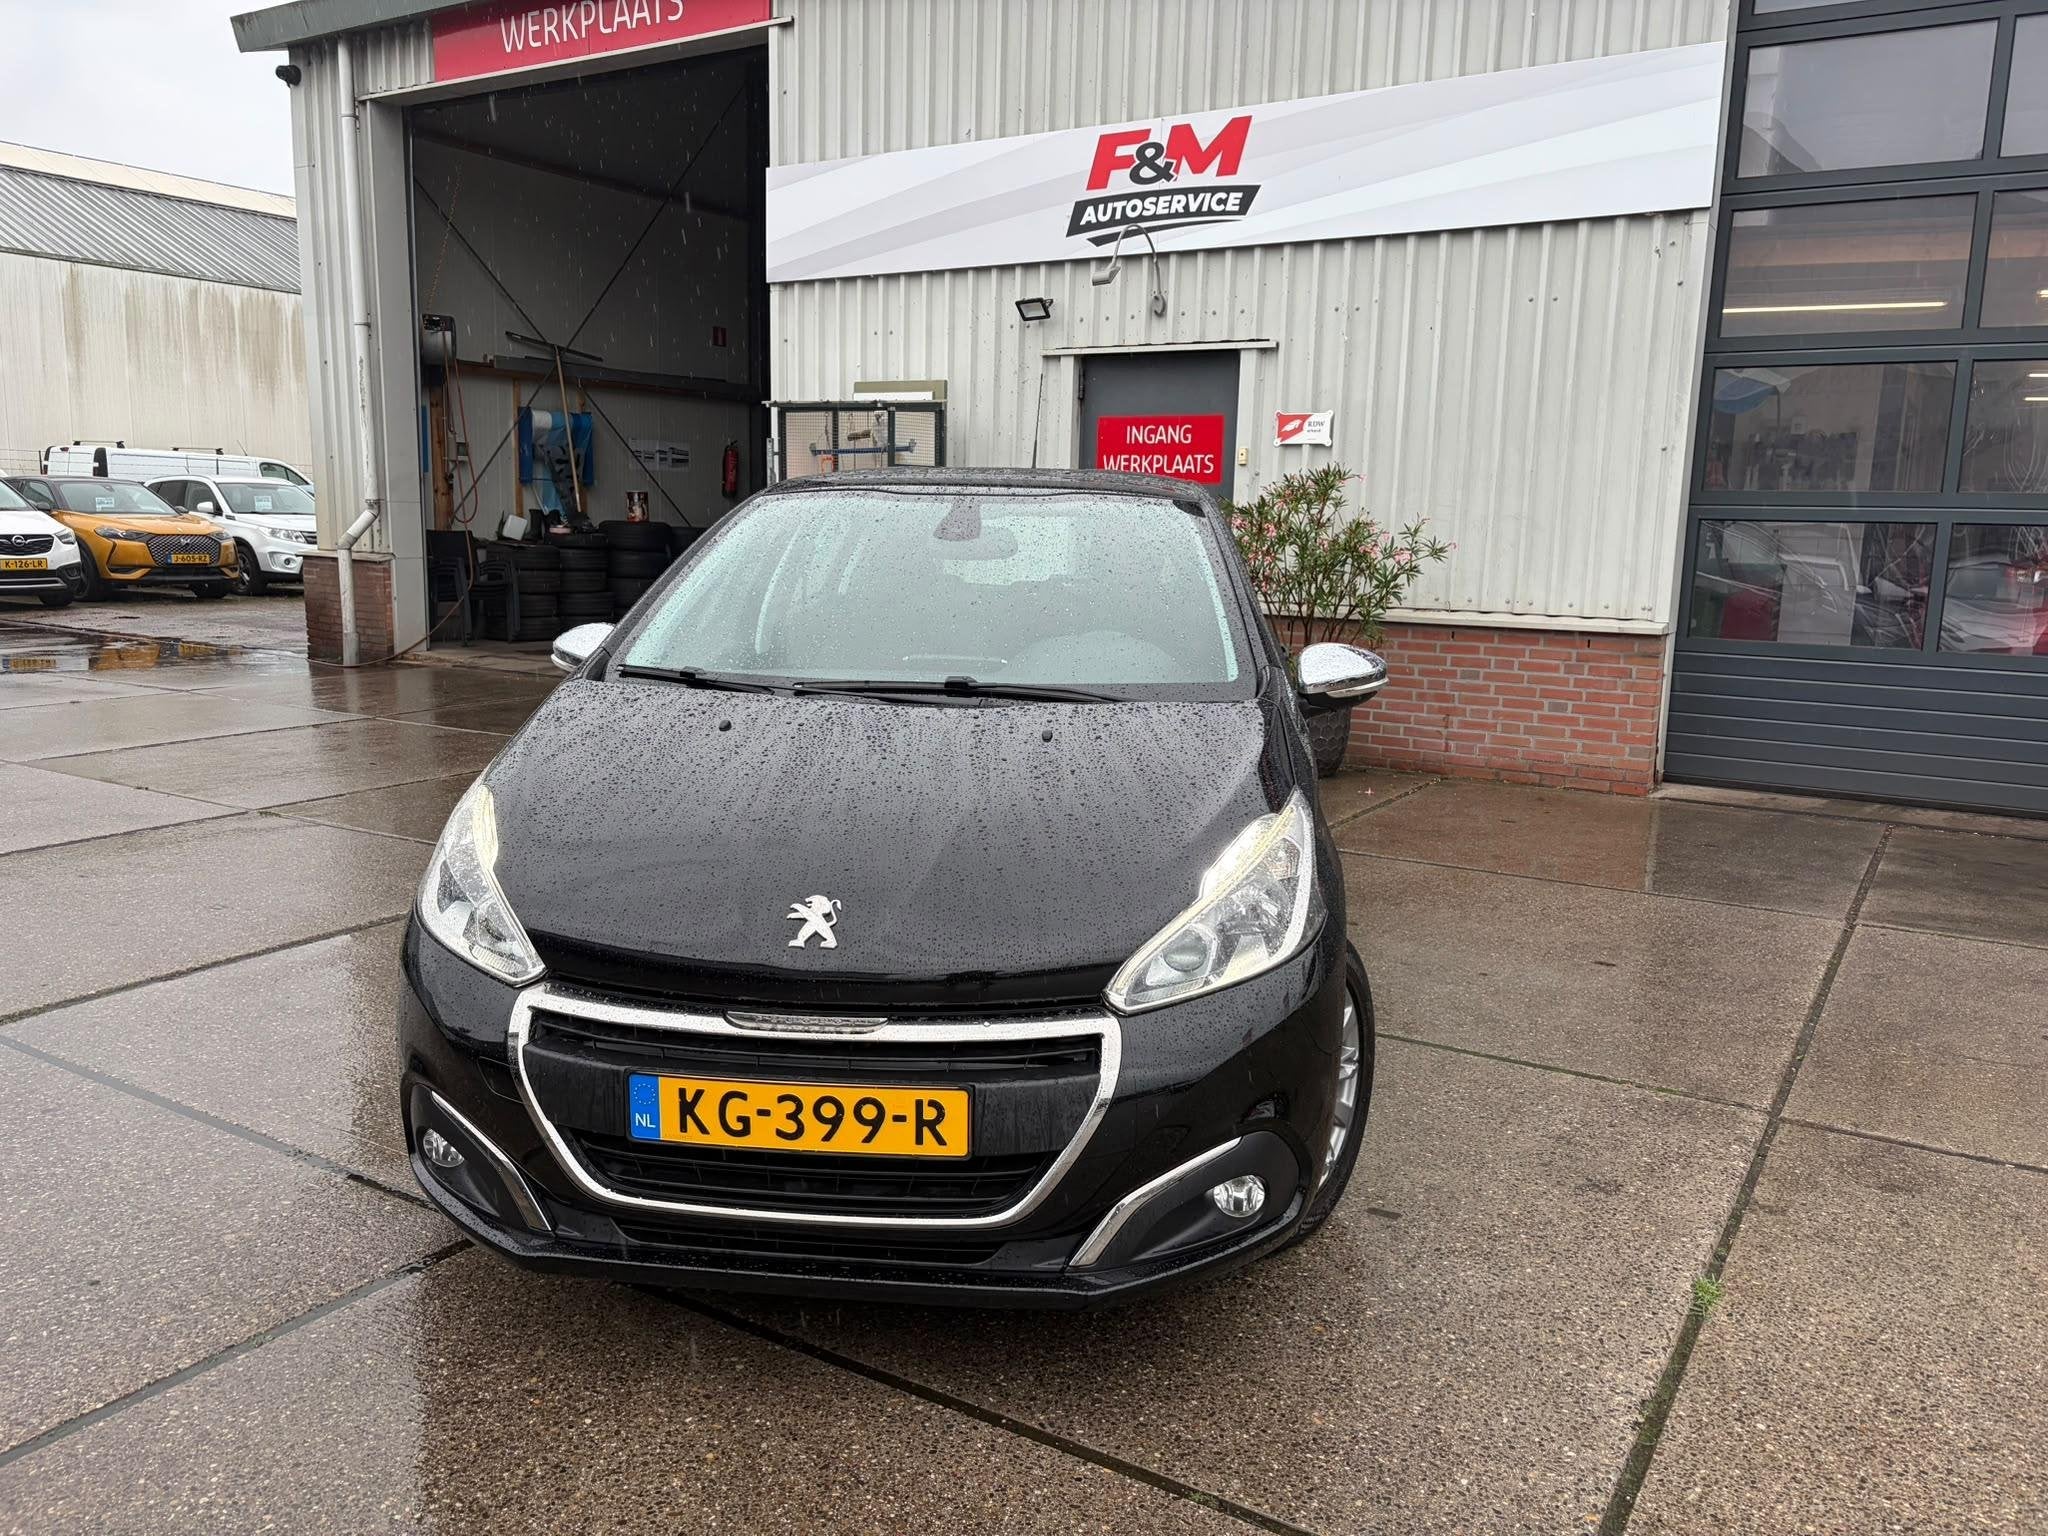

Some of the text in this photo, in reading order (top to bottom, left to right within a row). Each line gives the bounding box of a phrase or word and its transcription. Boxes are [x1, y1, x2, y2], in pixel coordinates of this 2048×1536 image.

[501, 0, 684, 53] WERKPLAATS
[1086, 115, 1252, 191] F&M
[1080, 192, 1244, 226] AUTOSERVICE
[1126, 424, 1193, 445] INGANG
[1103, 454, 1215, 474] WERKPLAATS
[4, 560, 44, 569] K-126-LR
[635, 1087, 948, 1147] NL KG-399-R
